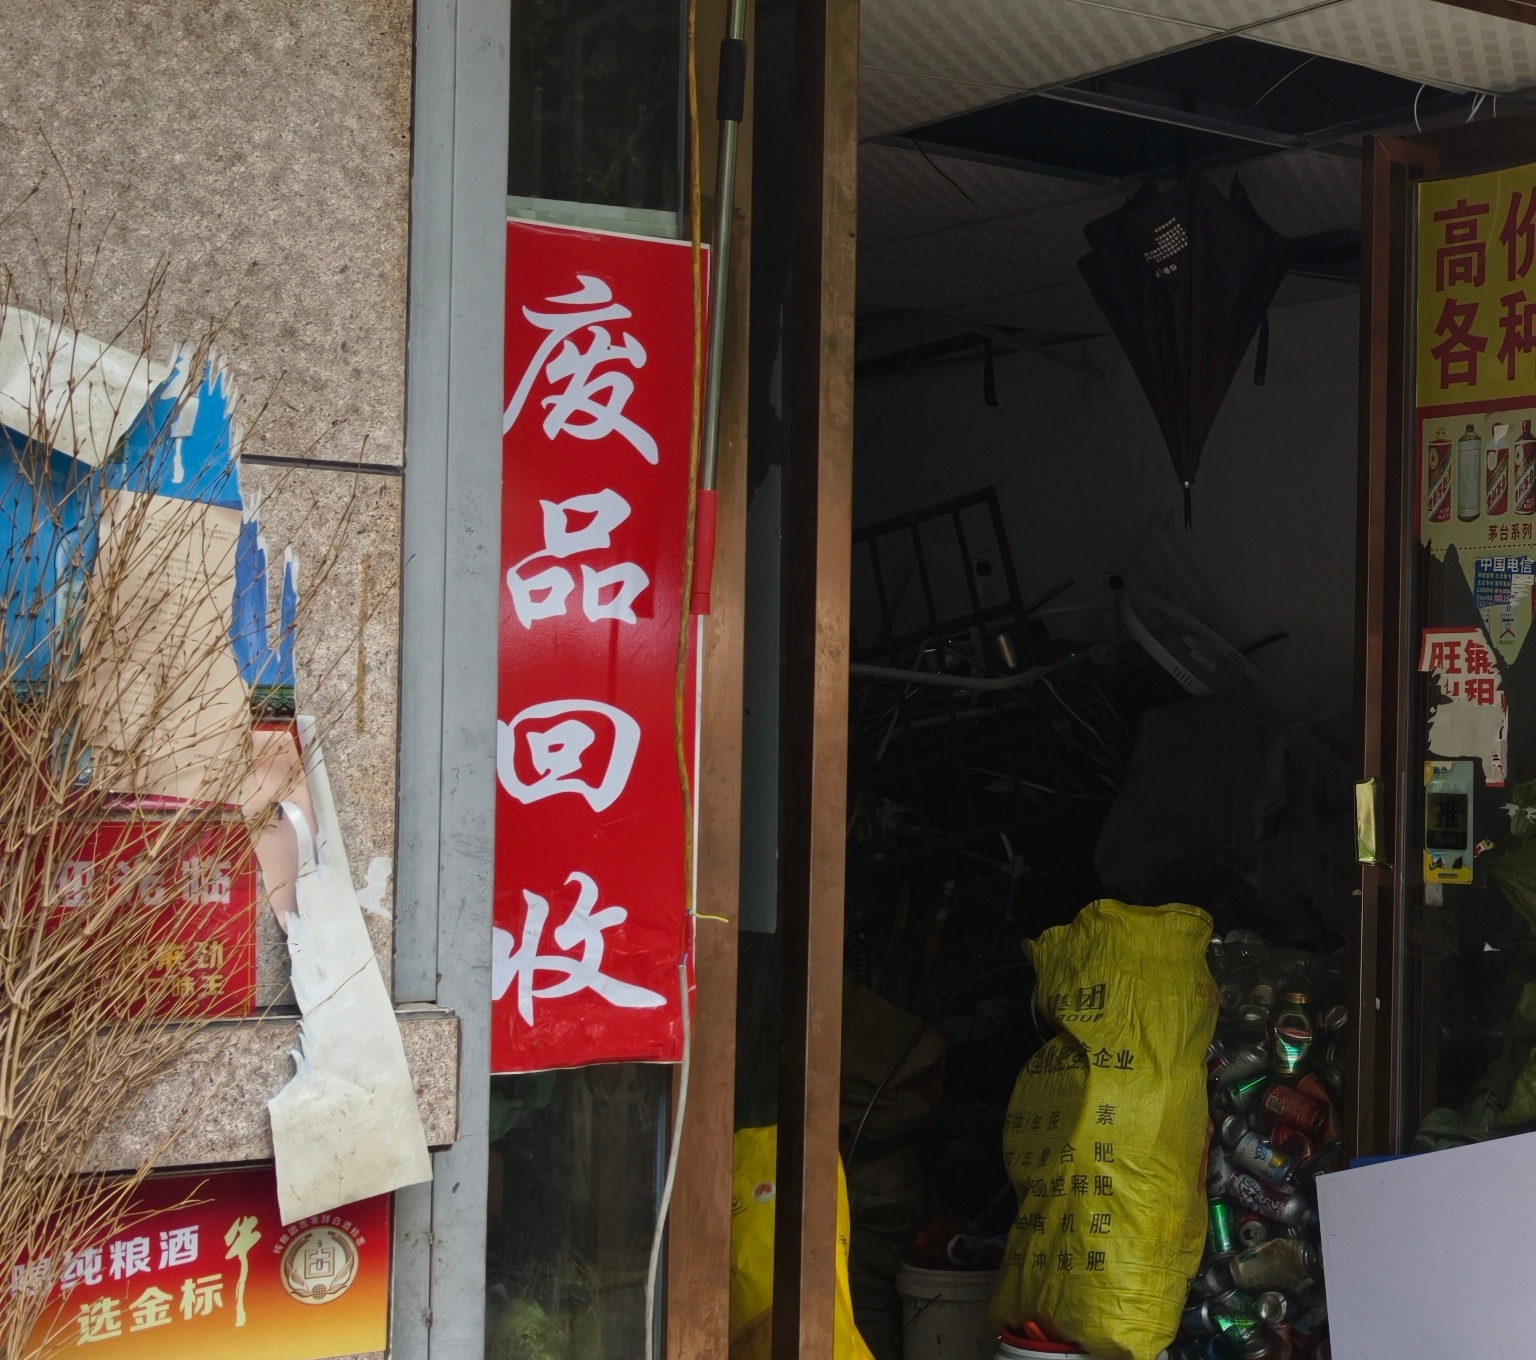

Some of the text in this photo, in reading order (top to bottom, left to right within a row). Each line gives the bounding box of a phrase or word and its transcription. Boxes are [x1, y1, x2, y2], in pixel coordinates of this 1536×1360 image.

[1487, 522, 1533, 542] 茅台系列
[1478, 555, 1536, 575] 中国电信
[491, 273, 667, 1029] 废品回收
[1031, 1173, 1115, 1199] 缓控释肥
